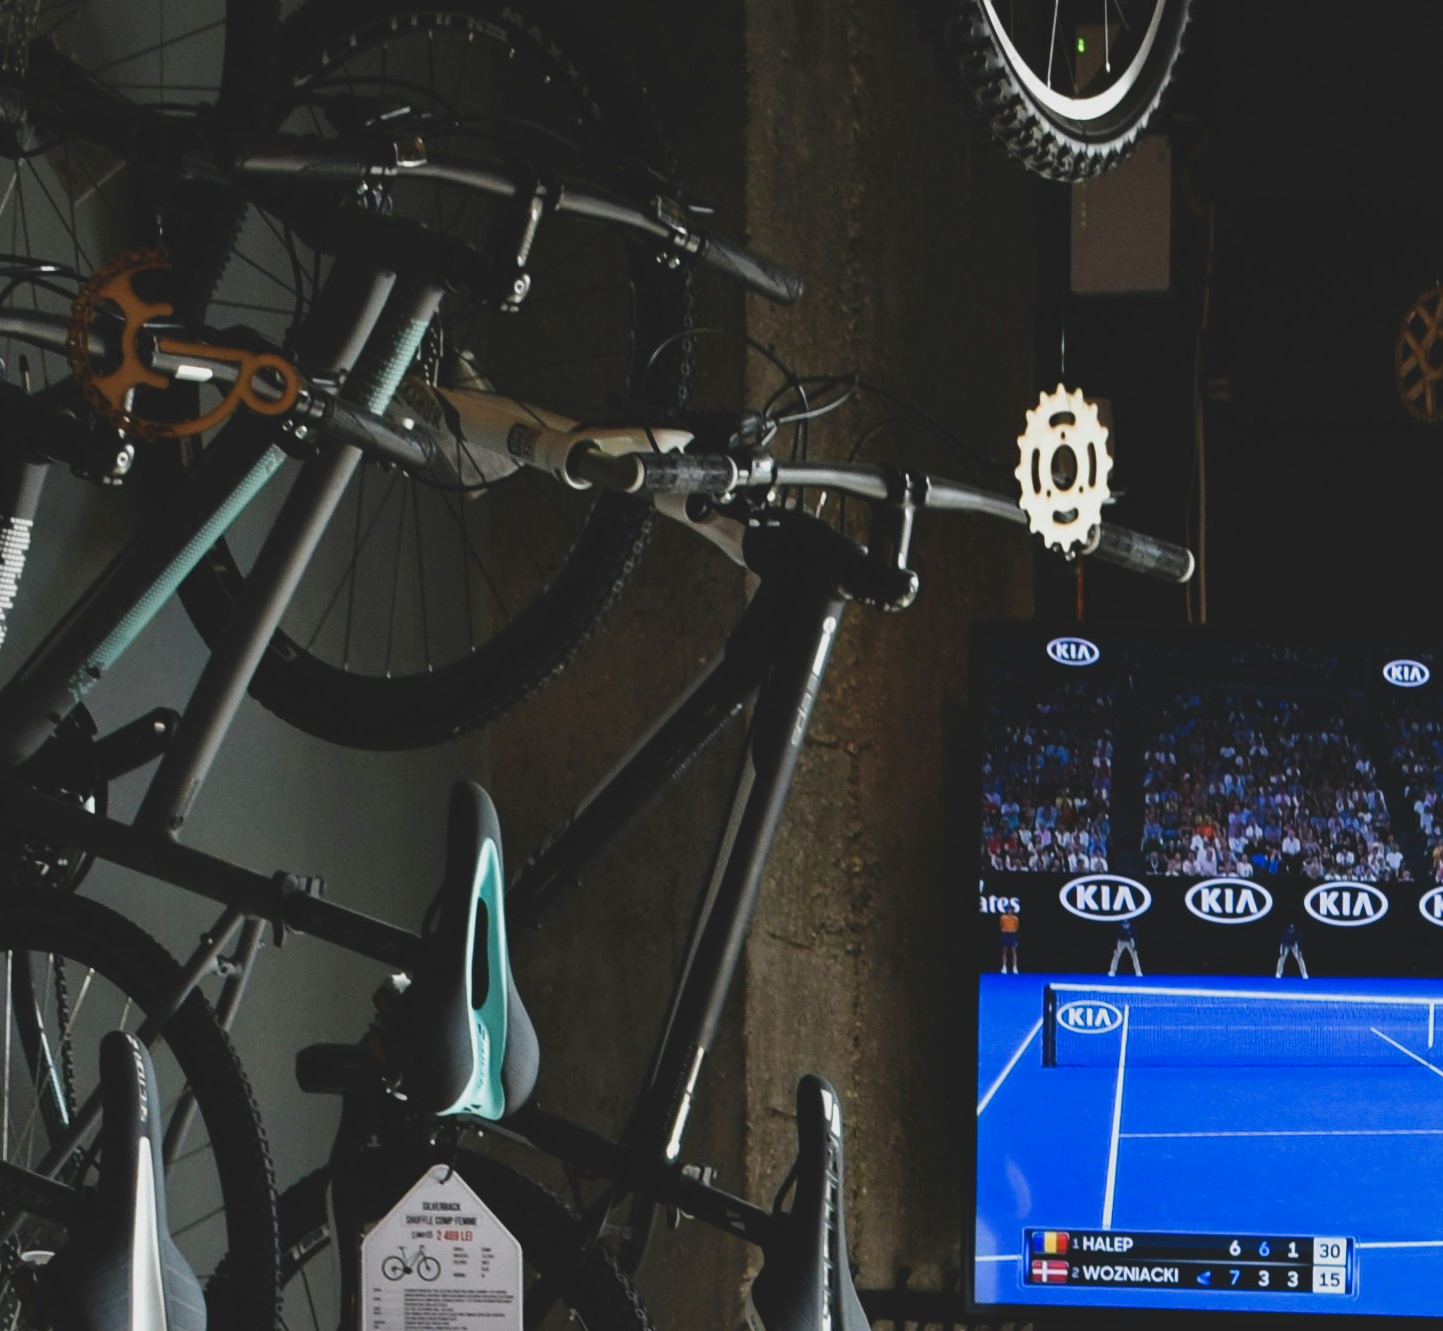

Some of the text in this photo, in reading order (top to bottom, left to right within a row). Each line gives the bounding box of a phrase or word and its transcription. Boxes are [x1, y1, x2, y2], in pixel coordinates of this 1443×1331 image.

[1075, 886, 1136, 911] KIA
[1200, 888, 1258, 913] KIA
[1319, 892, 1375, 917] KIA
[1068, 1007, 1112, 1027] KIA
[1082, 1236, 1134, 1253] HALEP
[1229, 1240, 1241, 1257] 6
[1258, 1241, 1270, 1257] 6
[1287, 1242, 1299, 1258] 1
[1318, 1243, 1341, 1259] 30
[1082, 1265, 1179, 1283] WOZNIACKI
[1229, 1270, 1240, 1285] 7
[1258, 1270, 1270, 1287] 3
[1287, 1271, 1299, 1287] 3
[1318, 1272, 1341, 1287] 15
